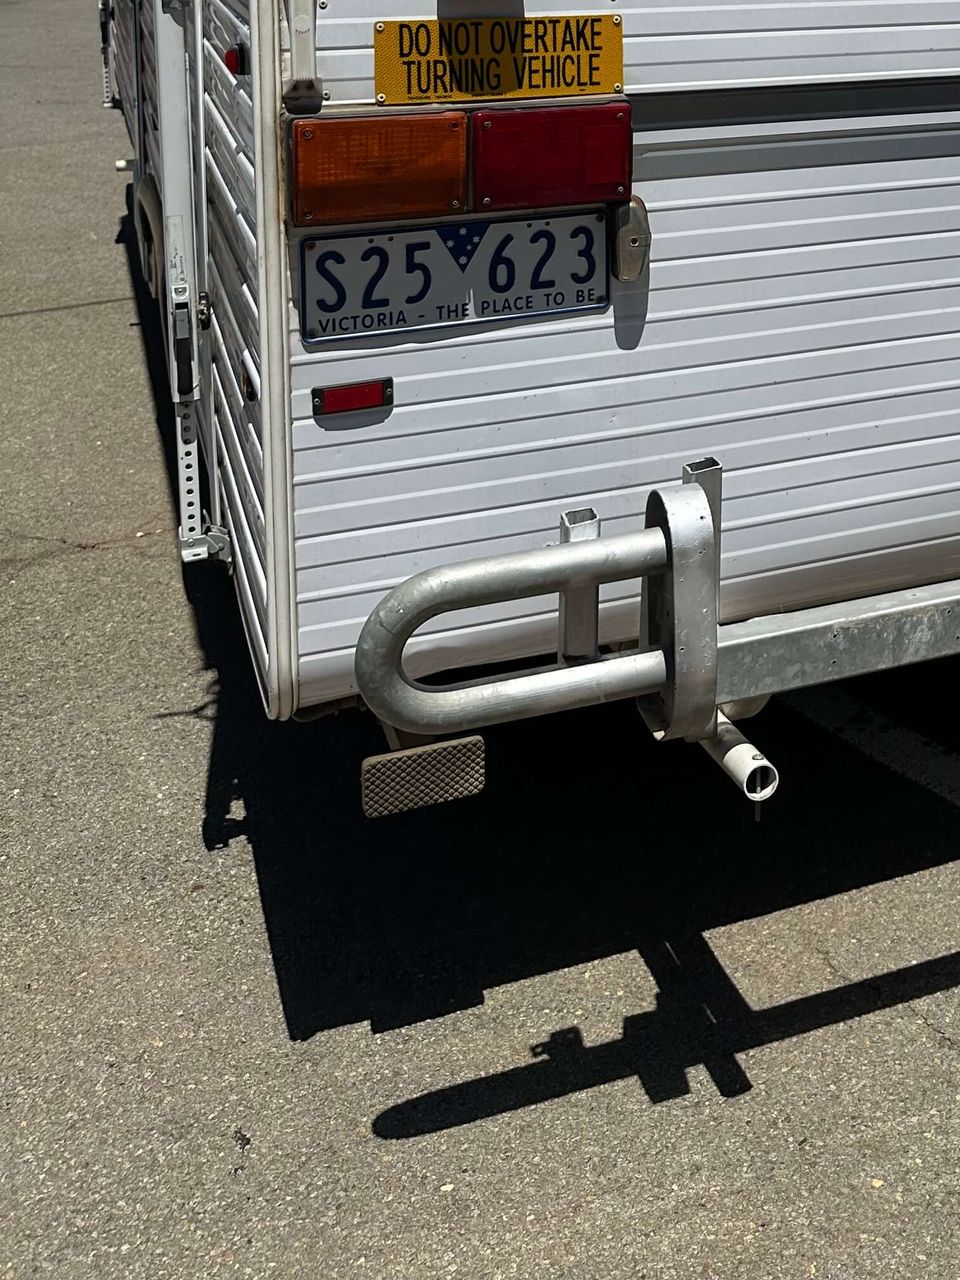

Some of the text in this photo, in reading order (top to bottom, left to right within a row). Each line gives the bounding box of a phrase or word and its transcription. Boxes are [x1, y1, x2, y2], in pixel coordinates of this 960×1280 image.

[399, 18, 603, 58] DO NOT OVERTAKE
[402, 54, 601, 94] TURNING VEHICLE
[315, 225, 597, 313] S25 623
[318, 310, 407, 334] VICTORIA
[436, 302, 471, 320] THE
[481, 295, 534, 315] PLACE
[543, 291, 565, 307] TO
[577, 288, 595, 303] BE
